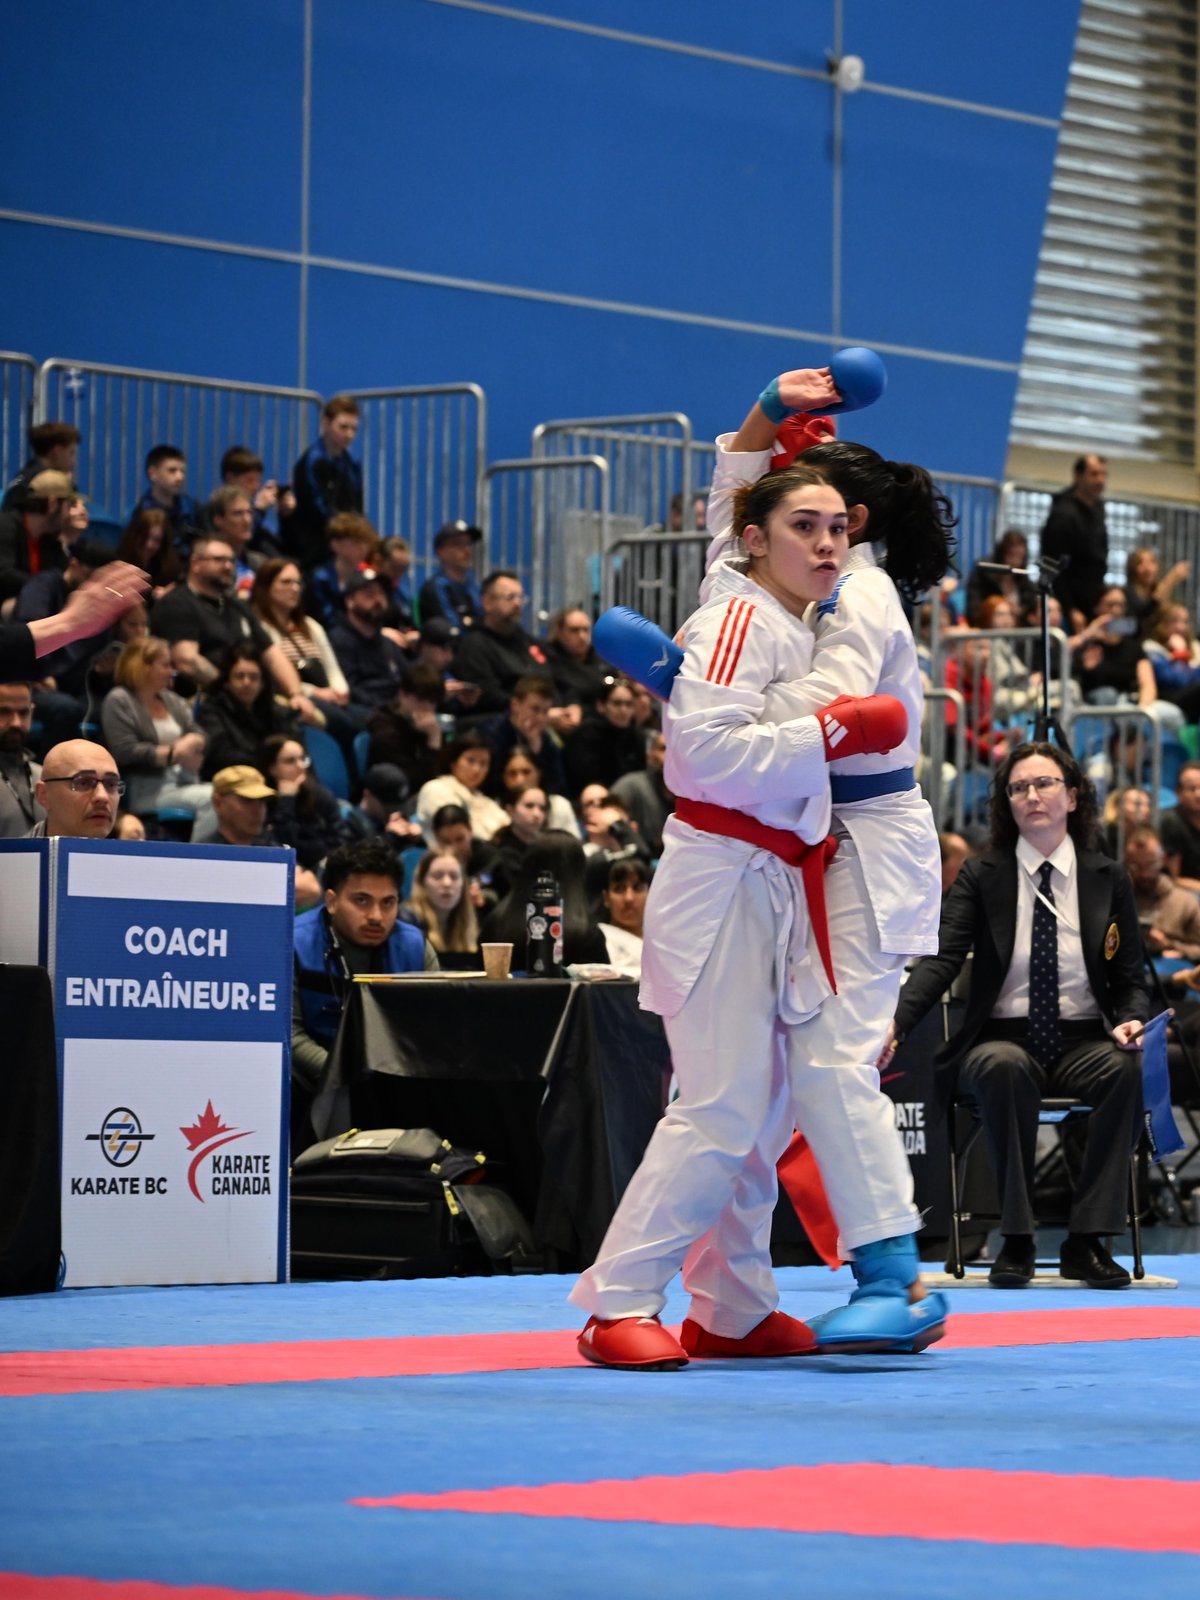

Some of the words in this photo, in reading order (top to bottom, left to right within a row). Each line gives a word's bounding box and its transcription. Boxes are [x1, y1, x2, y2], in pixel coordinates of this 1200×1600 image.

[124, 925, 228, 957] COACH
[212, 1154, 271, 1174] KARATE
[70, 1177, 140, 1196] KARATE
[144, 1177, 168, 1195] BC
[211, 1176, 271, 1196] CANADA
